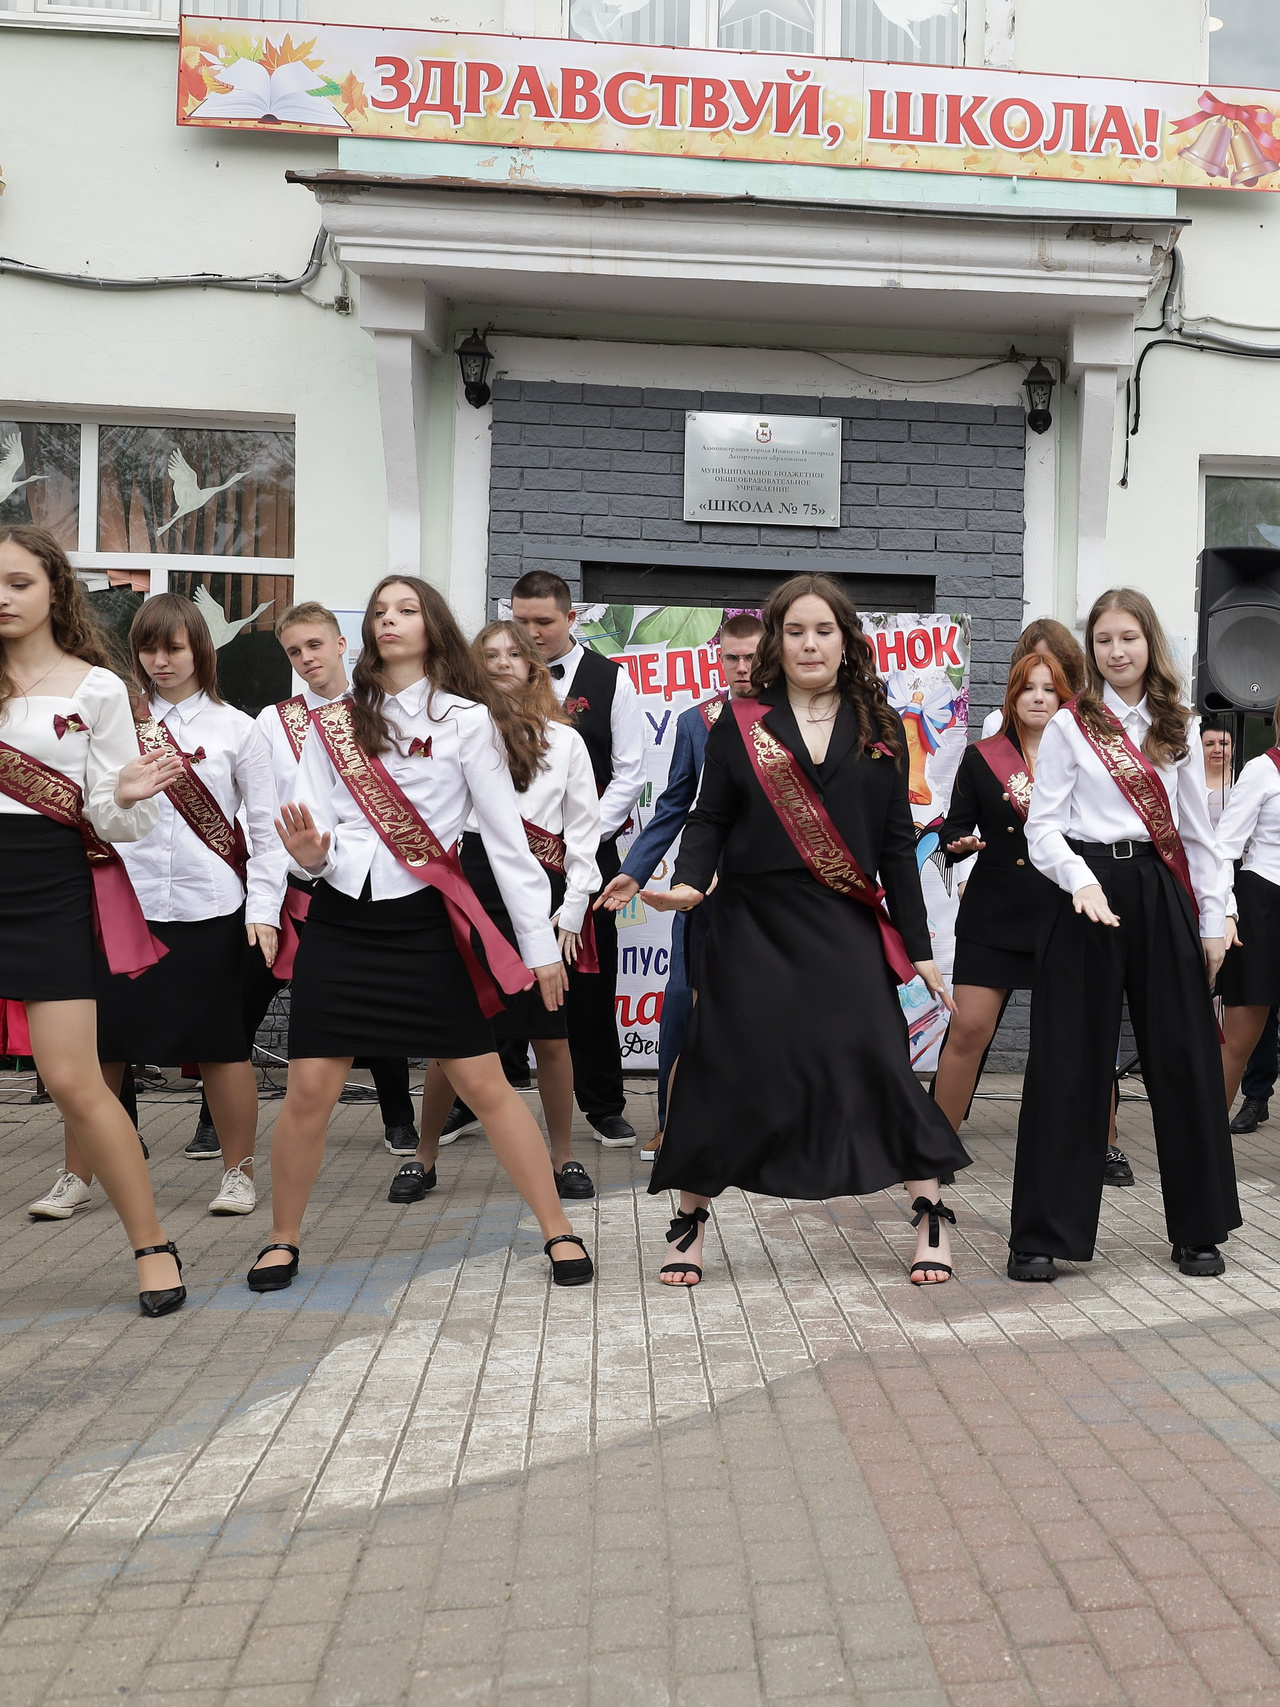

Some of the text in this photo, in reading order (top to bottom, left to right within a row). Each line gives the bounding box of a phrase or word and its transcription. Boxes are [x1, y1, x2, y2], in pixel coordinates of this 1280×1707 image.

[370, 56, 1162, 159] ЗДРАВСТВУЙ, ШКОЛА!
[701, 444, 750, 453] Администрация
[772, 448, 800, 456] Нижнего
[802, 449, 834, 457] Новгорода
[728, 452, 807, 463] Департамент образования
[700, 467, 825, 479] МУНИЦИПАЛЬНОЕ БЮДЖЕТНОЕ
[714, 476, 811, 486] ОБЩЕОБРАЗОВАТЕЛЬНОЕ
[736, 484, 790, 493] УЧРЕЖДЕНИЕ
[699, 499, 826, 516] «ШКОЛА № 75»
[198, 813, 236, 857] 2025
[380, 811, 442, 868] 2025
